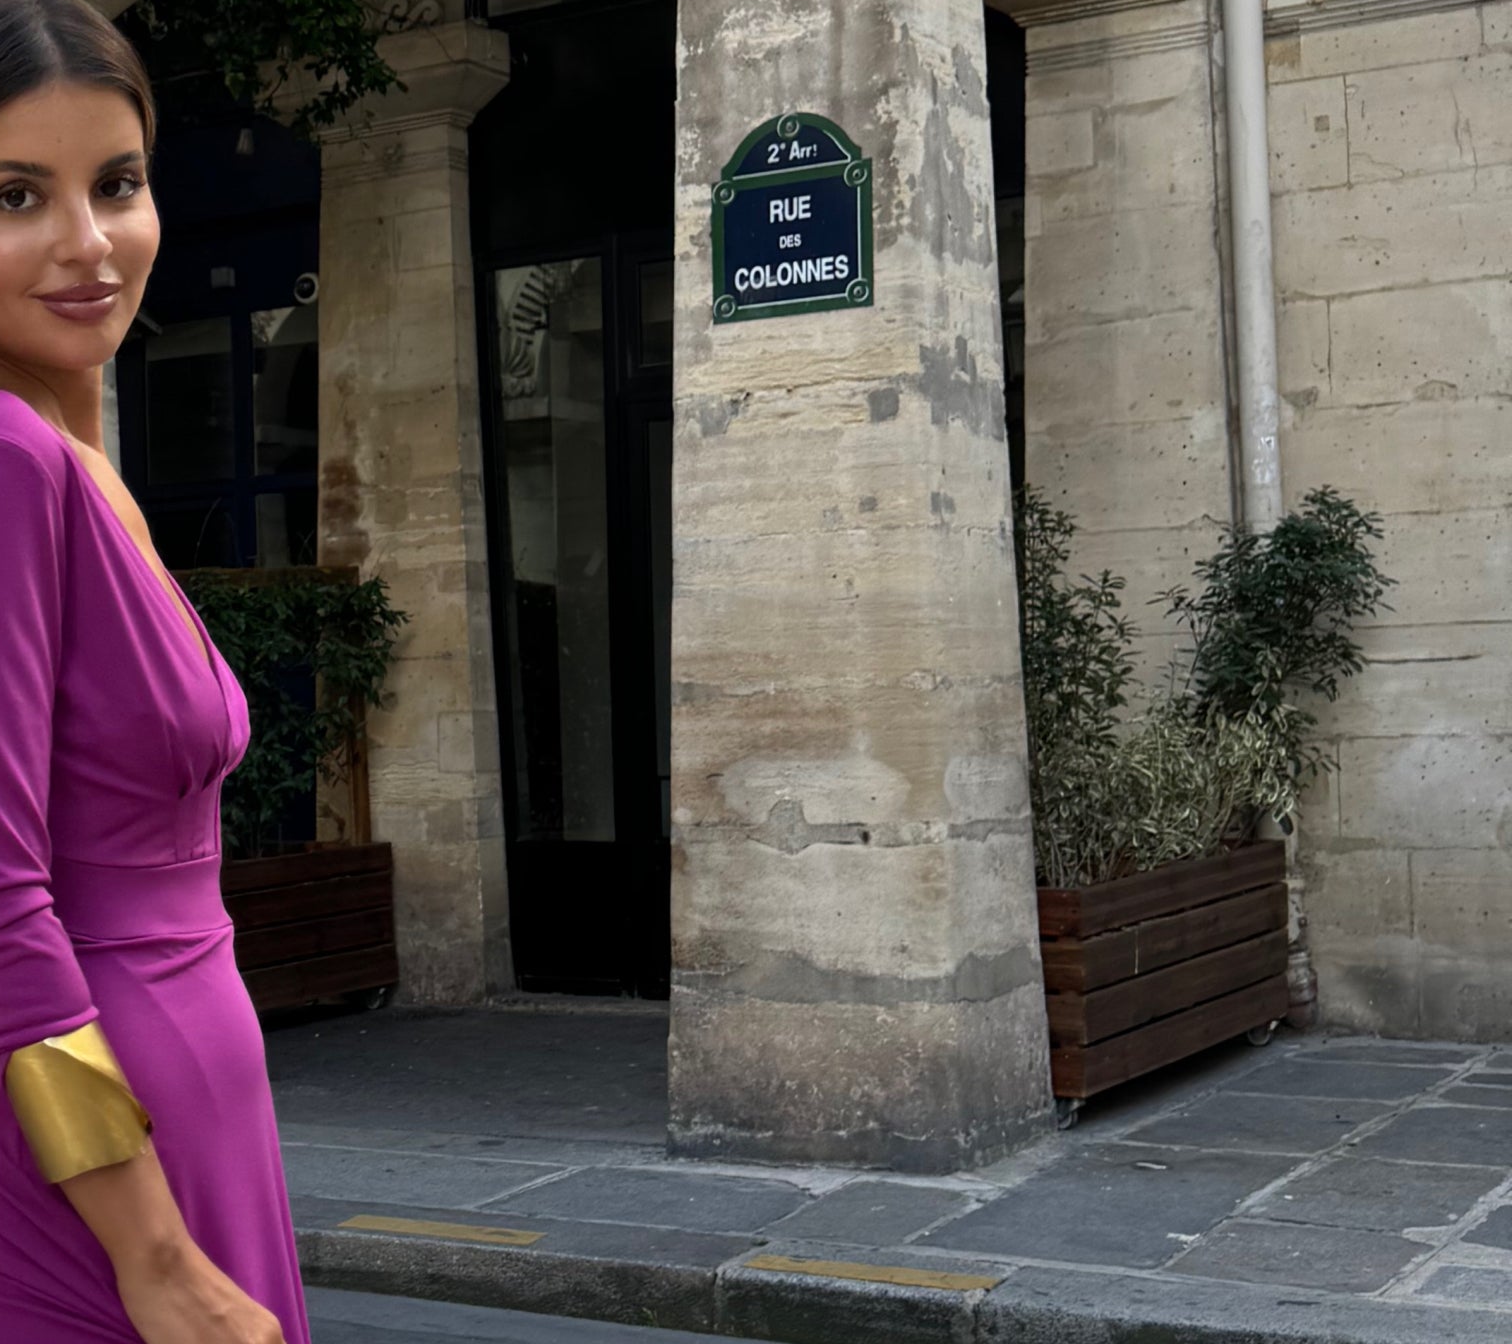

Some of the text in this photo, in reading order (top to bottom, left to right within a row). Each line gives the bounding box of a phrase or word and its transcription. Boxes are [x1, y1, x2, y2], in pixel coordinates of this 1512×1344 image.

[769, 195, 812, 223] RUE
[779, 233, 802, 249] DES
[734, 254, 850, 291] COLONNES
